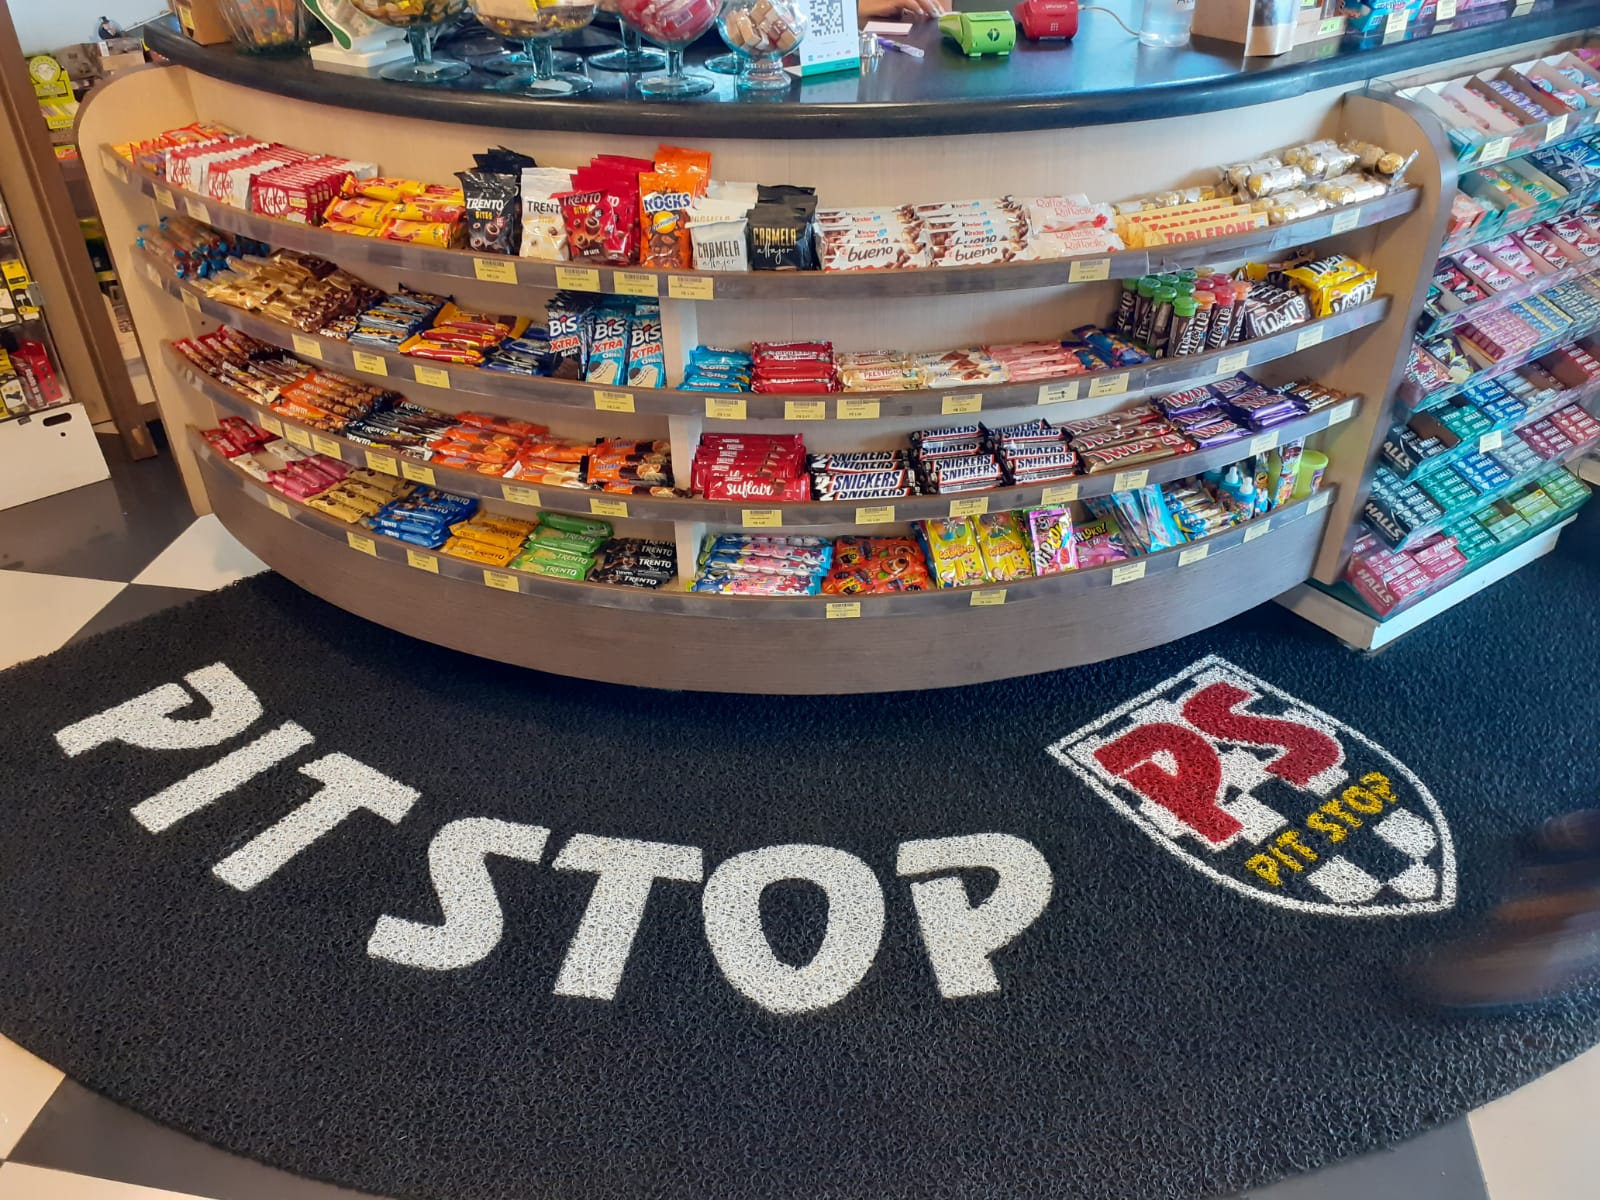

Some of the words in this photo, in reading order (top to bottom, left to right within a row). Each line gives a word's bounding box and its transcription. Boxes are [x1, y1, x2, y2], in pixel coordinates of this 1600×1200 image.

[209, 174, 234, 198] KitKat
[259, 187, 287, 214] KitKat
[466, 197, 505, 211] TRENTO
[528, 201, 562, 214] TRENT
[564, 193, 601, 206] TRENTO
[753, 226, 797, 246] CARMELA
[1164, 220, 1255, 246] TOBLERONE
[697, 240, 740, 258] CARMELA
[847, 246, 894, 262] bueno
[954, 246, 998, 261] bueno
[550, 337, 580, 353] XTRA
[593, 339, 624, 354] XTRA
[630, 344, 662, 361] XTRA
[1161, 387, 1211, 408] TWIX
[1082, 440, 1154, 463] TWIX
[1383, 441, 1411, 471] ALLS
[935, 454, 991, 469] SNICKERS
[1017, 453, 1073, 469] SNICKERS
[833, 472, 901, 490] SNICKERS
[942, 464, 998, 481] SNICKERS
[726, 481, 774, 498] suflair
[442, 493, 471, 506] TRENTO
[1365, 502, 1402, 541] HALLS
[556, 553, 589, 564] TRENTO
[641, 544, 673, 557] TRENTO
[545, 565, 577, 576] TRENTO
[639, 558, 672, 569] TRENTO
[623, 575, 657, 585] TRENTO
[1356, 568, 1394, 607] HALLS
[54, 661, 422, 892] PIT
[1244, 829, 1319, 887] PIT
[1306, 771, 1398, 844] STOP
[367, 815, 1054, 1016] STOP
